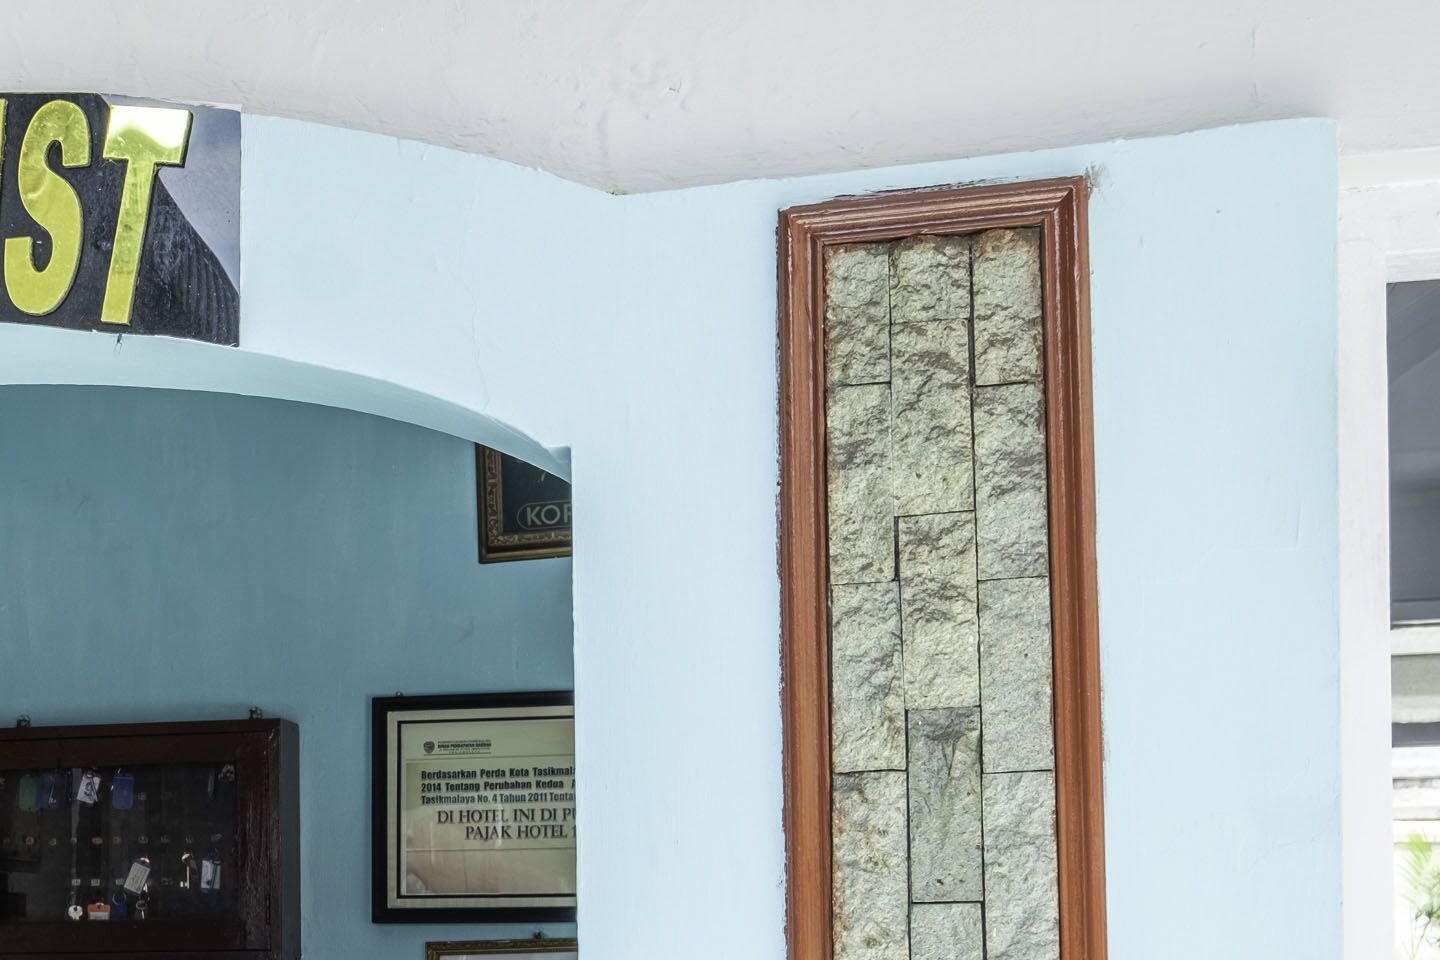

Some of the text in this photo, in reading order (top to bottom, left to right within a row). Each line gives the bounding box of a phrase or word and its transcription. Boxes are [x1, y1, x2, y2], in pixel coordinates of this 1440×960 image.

[421, 770, 476, 779] Berdasarkan
[480, 768, 505, 778] Perda
[509, 768, 529, 777] Kota
[421, 780, 563, 792] 2014 Tentang Perubahan Kedua
[421, 794, 475, 804] Tasikmalaya
[477, 794, 490, 804] No.
[492, 794, 497, 803] 4
[499, 793, 526, 802] Tahun
[528, 793, 548, 801] 2011
[437, 810, 453, 824] DI
[459, 809, 508, 823] HOTEL
[513, 808, 536, 822] INI
[540, 808, 557, 822] DI
[465, 825, 567, 840] PAJAK HOTEL
